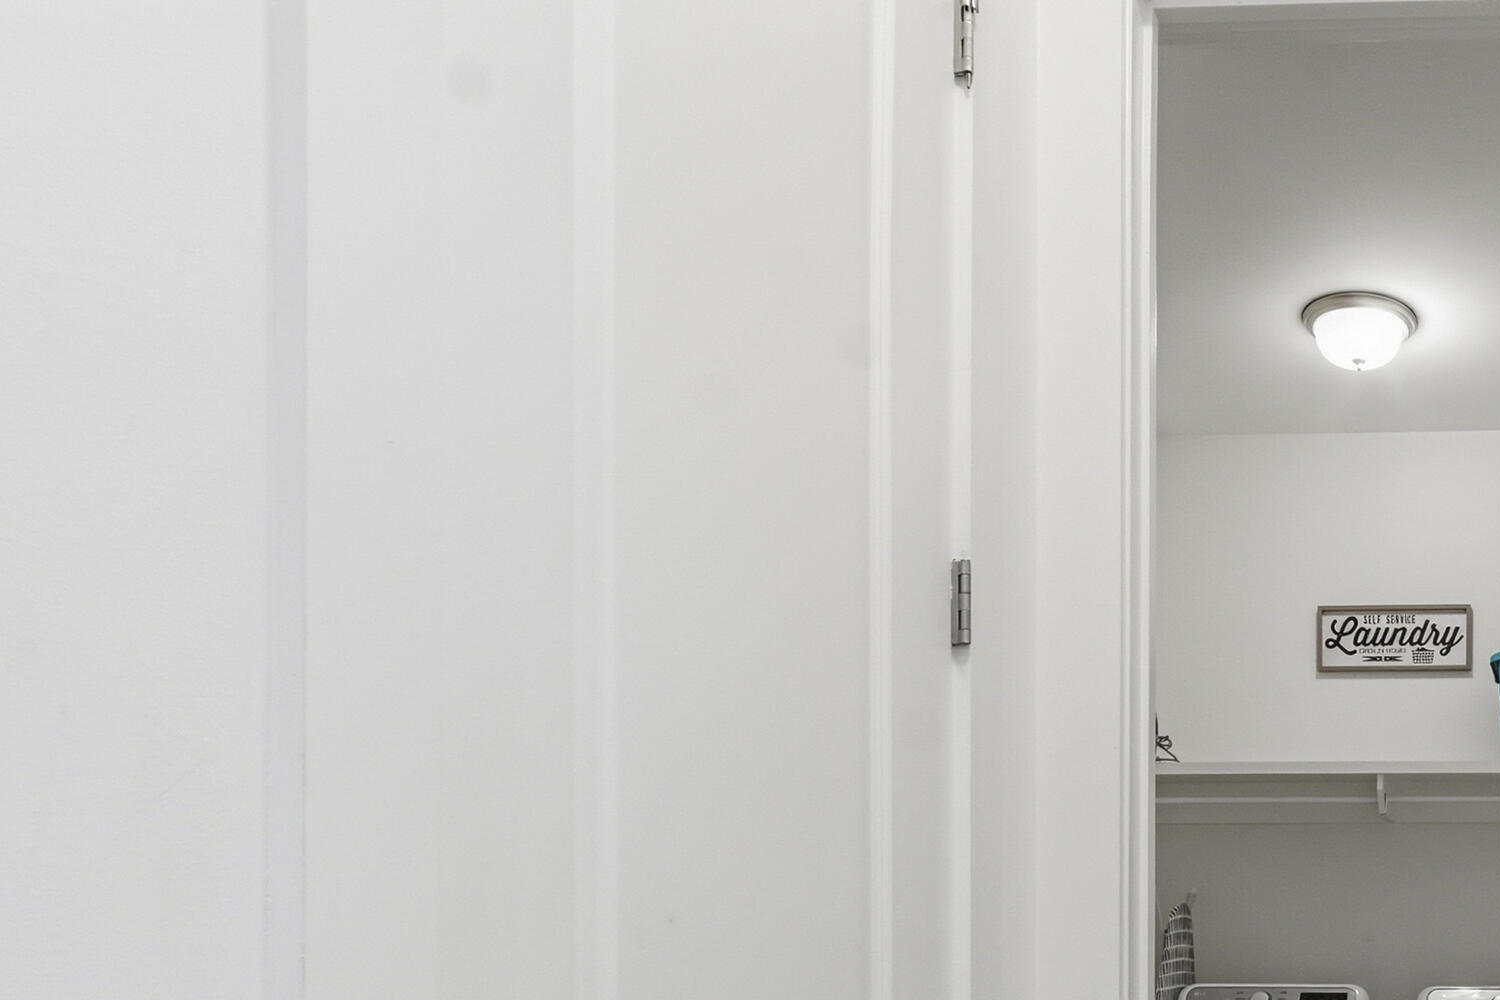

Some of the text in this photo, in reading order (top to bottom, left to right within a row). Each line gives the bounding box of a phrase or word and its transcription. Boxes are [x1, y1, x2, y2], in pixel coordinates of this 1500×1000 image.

[1363, 614, 1416, 625] SELF SERVICE
[1324, 616, 1464, 657] Laundry
